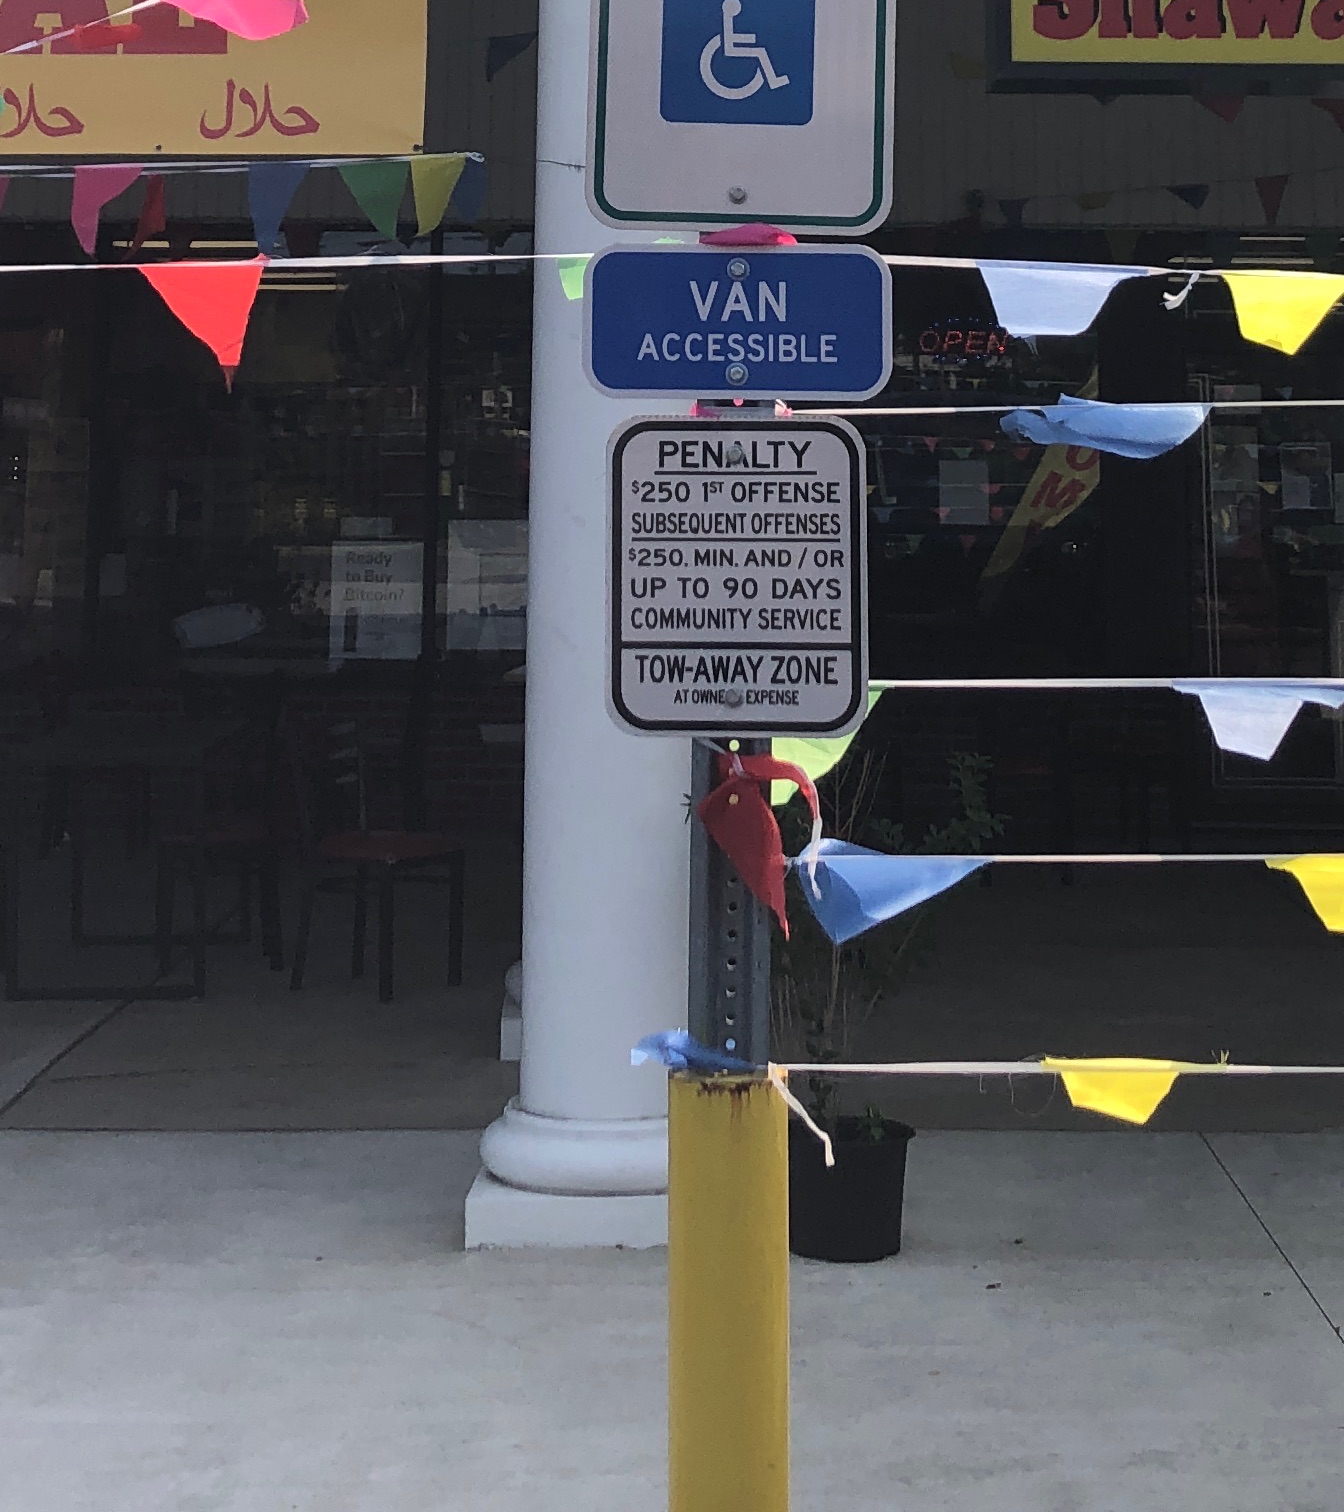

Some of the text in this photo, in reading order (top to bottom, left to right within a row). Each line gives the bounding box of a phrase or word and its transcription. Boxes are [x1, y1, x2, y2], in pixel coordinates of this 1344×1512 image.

[199, 78, 320, 140] حلال
[690, 280, 787, 323] VAN
[637, 333, 838, 364] ACCESSIBLE
[919, 329, 1008, 355] OPEN
[631, 480, 841, 504] $250 1ST OFFENSE
[631, 512, 841, 535] SUBSEQUENT OFFENSES
[345, 551, 392, 567] Ready
[694, 549, 739, 568] MIN.
[744, 549, 792, 568] AND
[813, 549, 845, 568] OR
[345, 570, 392, 585] to Buy
[630, 577, 842, 600] UP TO 90 DAYS
[345, 588, 404, 601] Bitcoin?
[630, 607, 842, 631] COMMUNITY SERVICE
[635, 654, 839, 685] TOW-AWAY ZONE
[673, 689, 800, 706] AT OWNE EXPENSE
